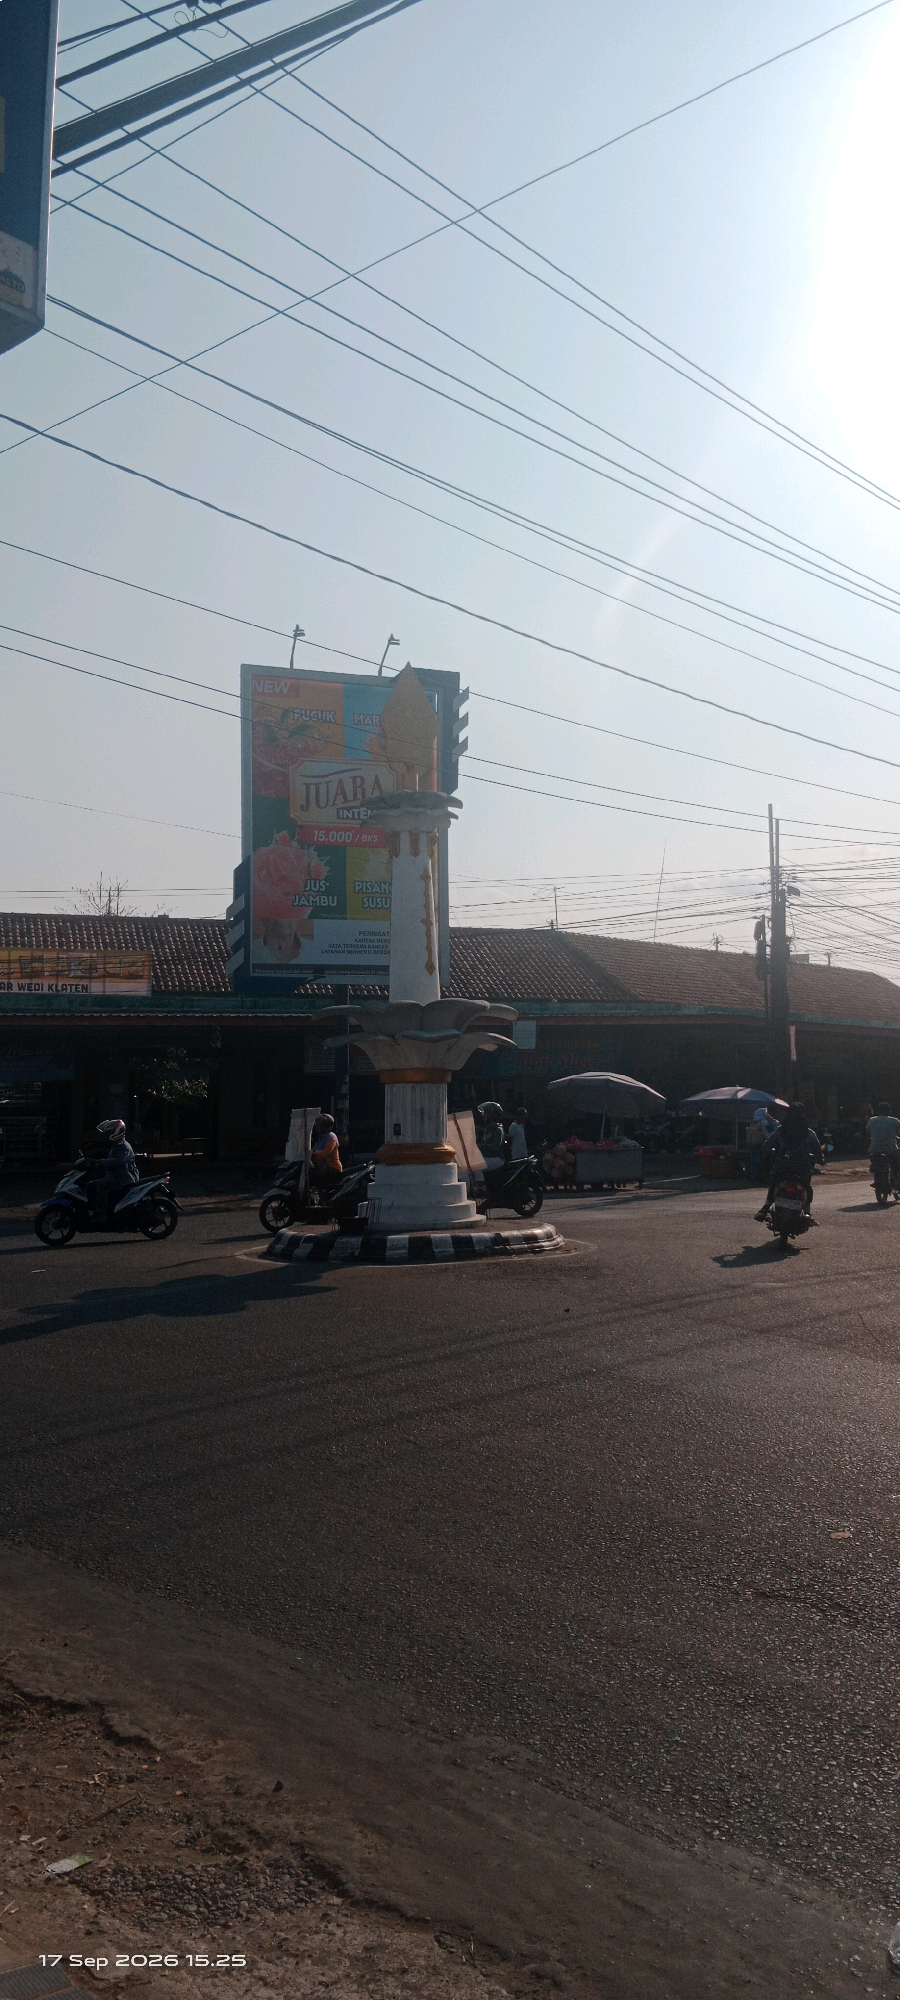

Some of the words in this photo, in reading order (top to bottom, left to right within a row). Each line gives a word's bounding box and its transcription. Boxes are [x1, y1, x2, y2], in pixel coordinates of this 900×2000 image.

[252, 679, 291, 694] NEW
[293, 709, 335, 723] PUCUK
[301, 774, 383, 812] JUARA
[361, 834, 378, 842] BKS
[354, 881, 392, 894] PISAN
[293, 895, 338, 907] JAMBU
[363, 897, 390, 909] SUSU
[18, 982, 44, 992] WEDI
[47, 983, 89, 993] KLATEN
